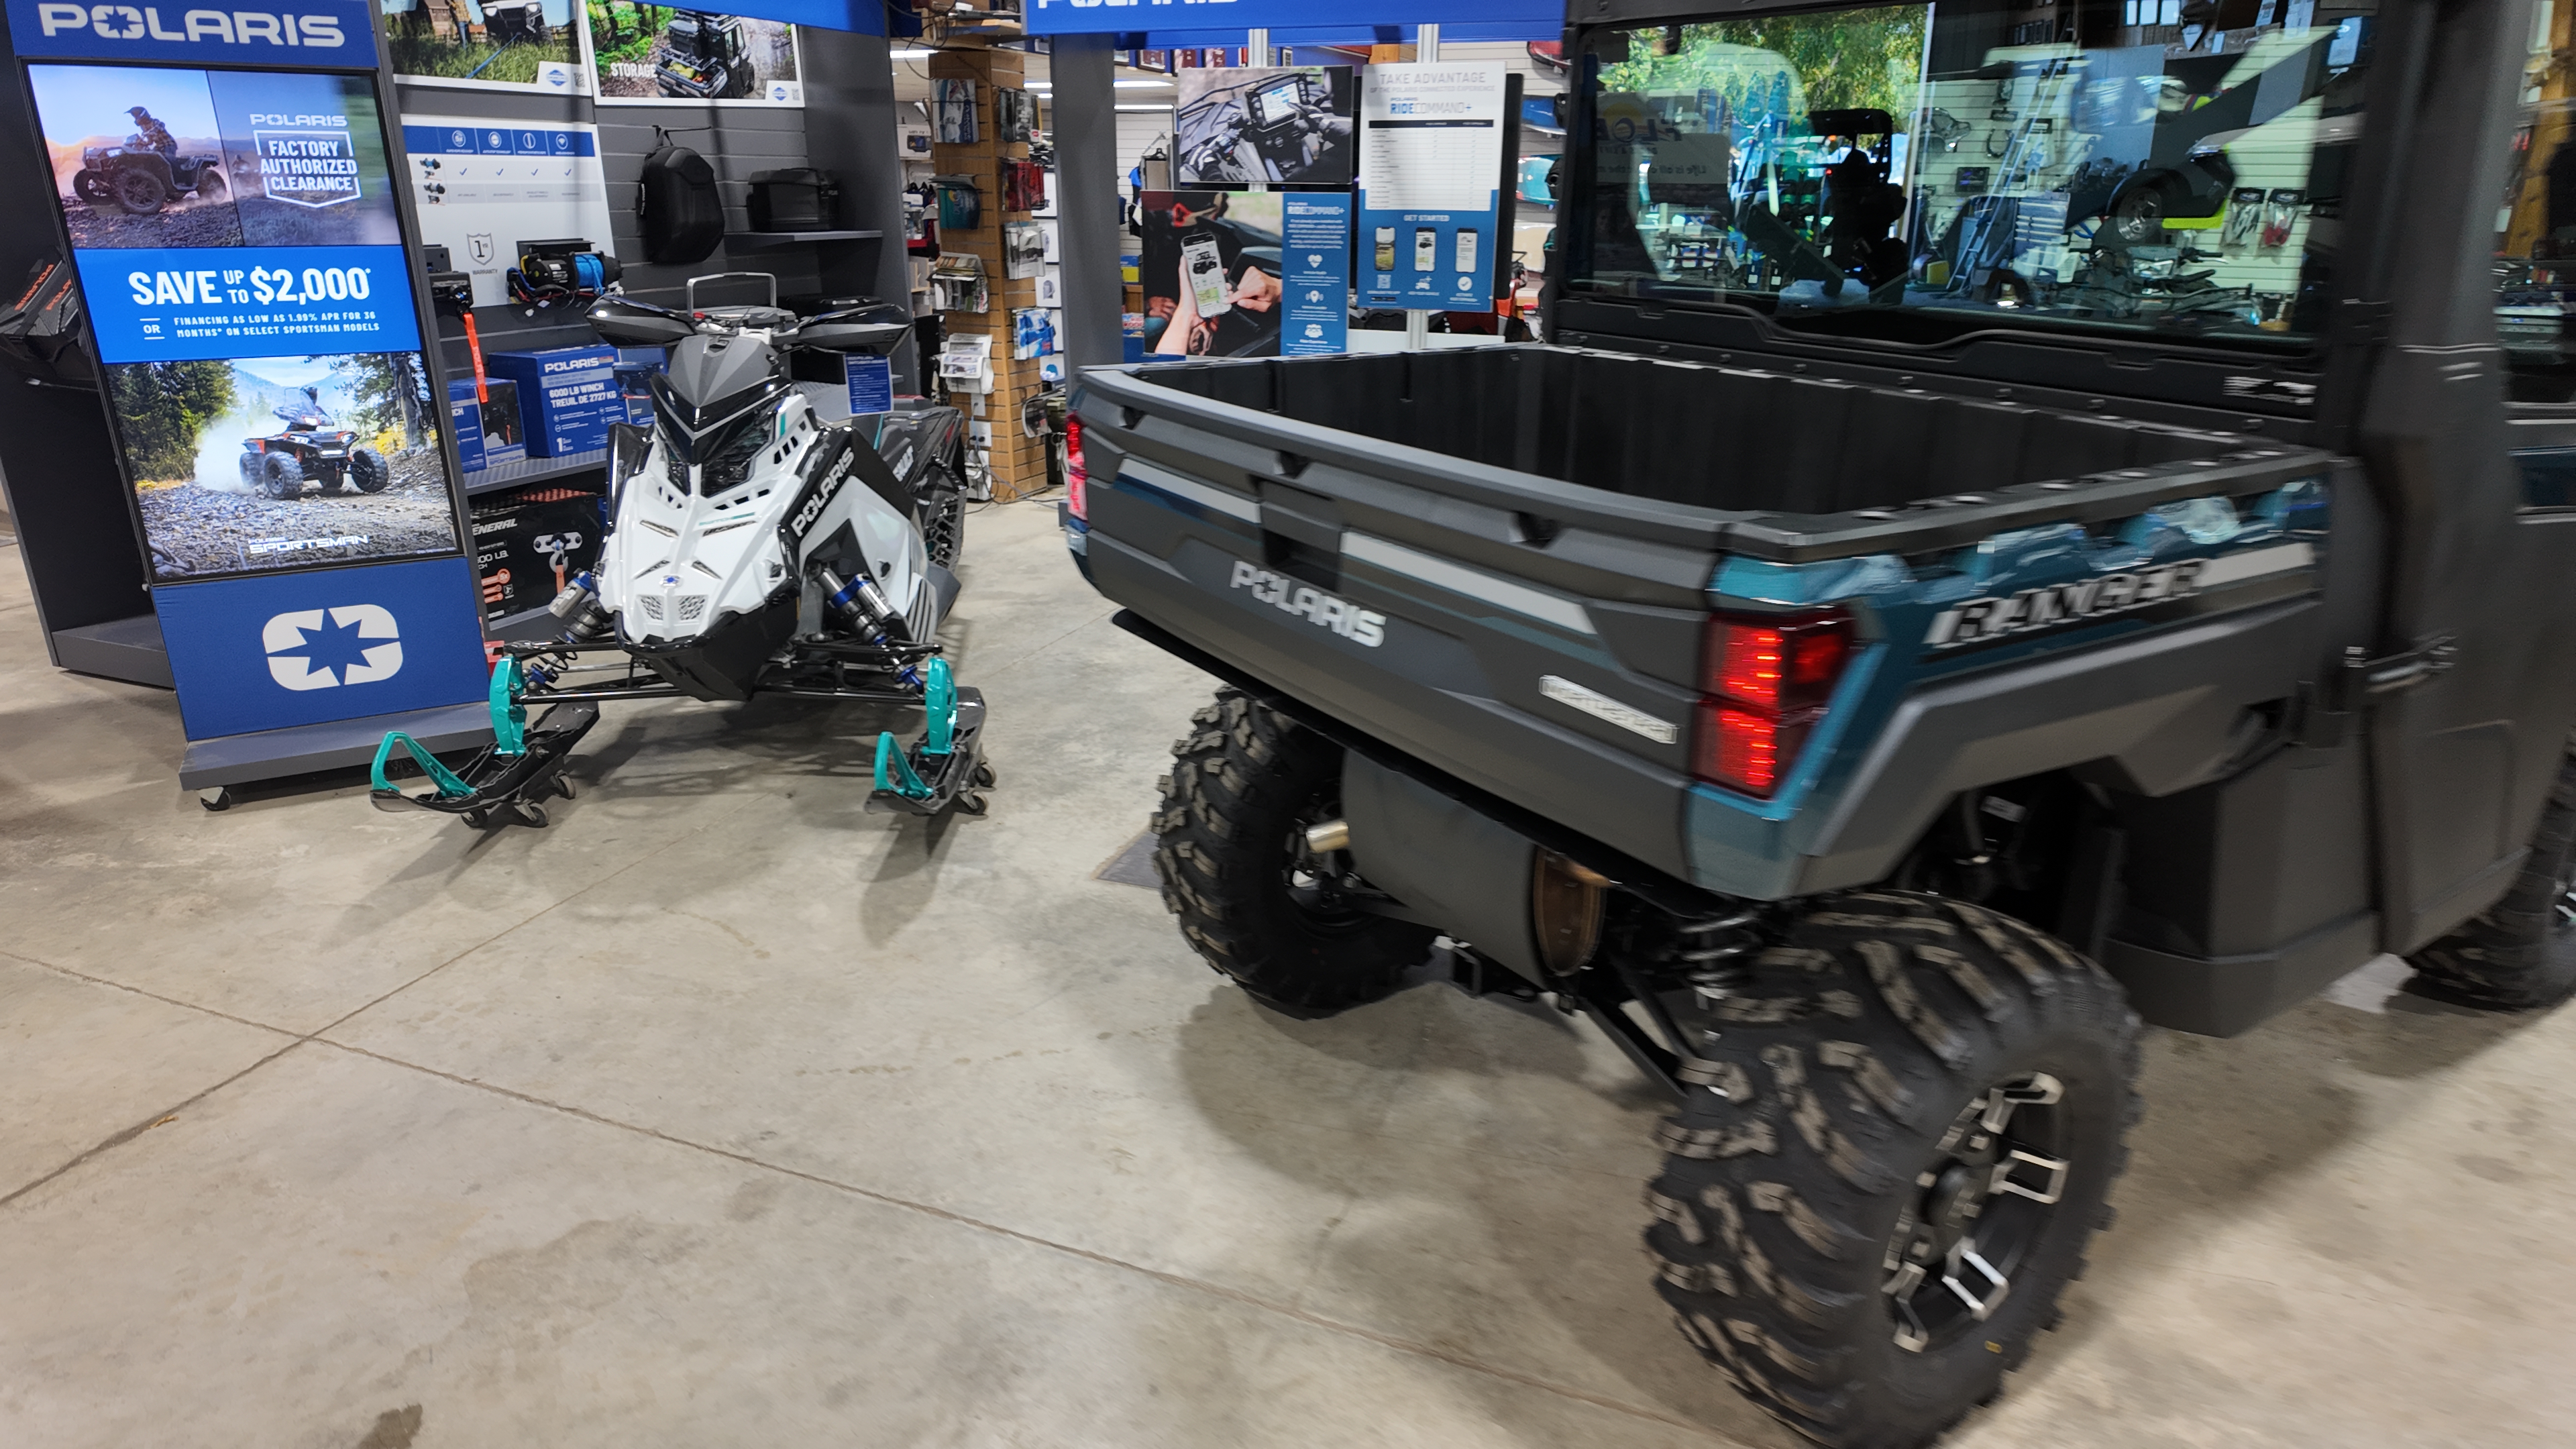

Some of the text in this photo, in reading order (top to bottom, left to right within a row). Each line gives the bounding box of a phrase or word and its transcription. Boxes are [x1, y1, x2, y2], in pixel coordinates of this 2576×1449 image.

[38, 3, 345, 48] POLARIS
[610, 62, 658, 78] STORAGE
[1380, 72, 1487, 85] TAKE ADVANTAGE
[250, 113, 347, 127] POLARIS
[268, 140, 338, 157] FACTORY
[260, 158, 358, 174] AUTHORIZED
[270, 176, 354, 191] CLEARANCE
[474, 240, 485, 258] 1
[223, 270, 244, 285] UP
[128, 270, 223, 306] SAVE
[227, 289, 249, 305] TO
[174, 316, 229, 325] FINANCING
[233, 315, 246, 324] AS
[248, 315, 269, 323] LOW
[273, 314, 285, 323] AS
[321, 313, 339, 321] APR
[343, 312, 361, 321] FOR
[144, 325, 161, 334] OR
[226, 327, 240, 336] ON
[243, 326, 279, 335] SELECT
[283, 323, 340, 334] SPORTSMAN
[343, 323, 380, 332] MODELS
[544, 357, 599, 373] POLARIS
[549, 388, 569, 398] 6000
[569, 386, 580, 395] LB
[580, 382, 604, 394] WINCH
[551, 390, 616, 408] TREUIL DE 2727 KG
[791, 447, 855, 537] POLARIS
[472, 518, 518, 536] ENERAL
[249, 535, 369, 554] SPORTSMAN
[1230, 559, 1387, 648] POLARIS
[1921, 557, 2209, 649] RANGER
